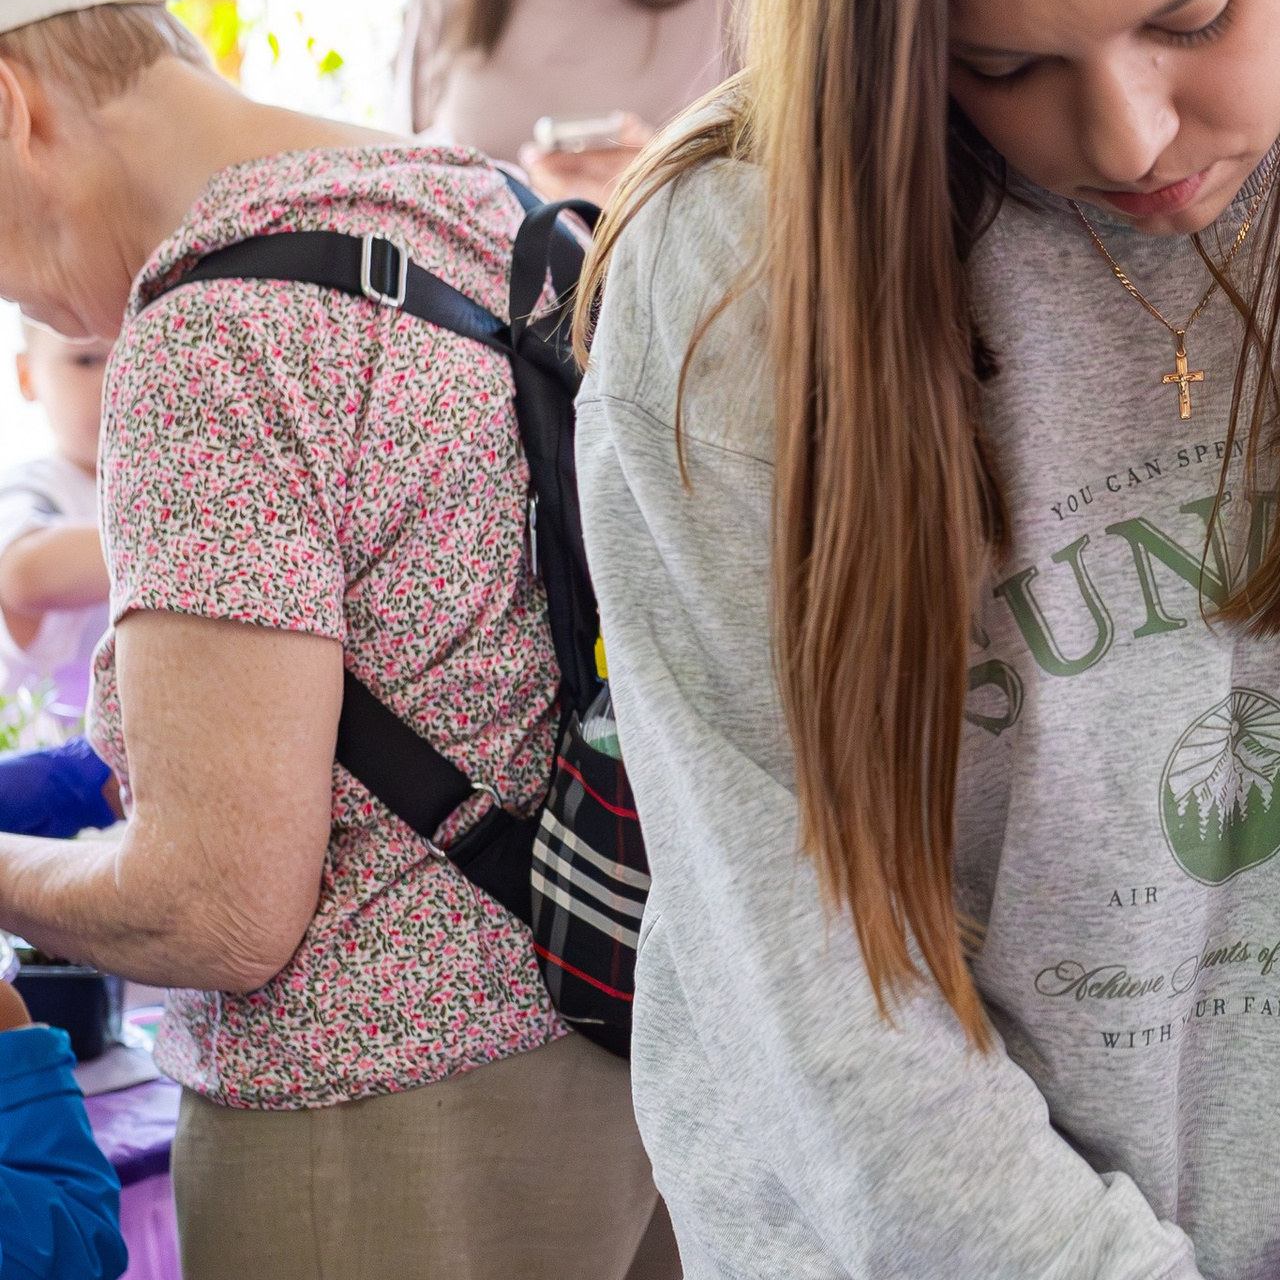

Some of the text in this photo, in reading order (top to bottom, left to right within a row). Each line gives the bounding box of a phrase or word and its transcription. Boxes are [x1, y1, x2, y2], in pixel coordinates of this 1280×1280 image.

[1050, 485, 1094, 521] YOU
[1105, 458, 1164, 493] CAN
[1106, 886, 1159, 908] AIR
[1033, 959, 1165, 1003] Achieve
[1100, 1023, 1173, 1049] WITH
